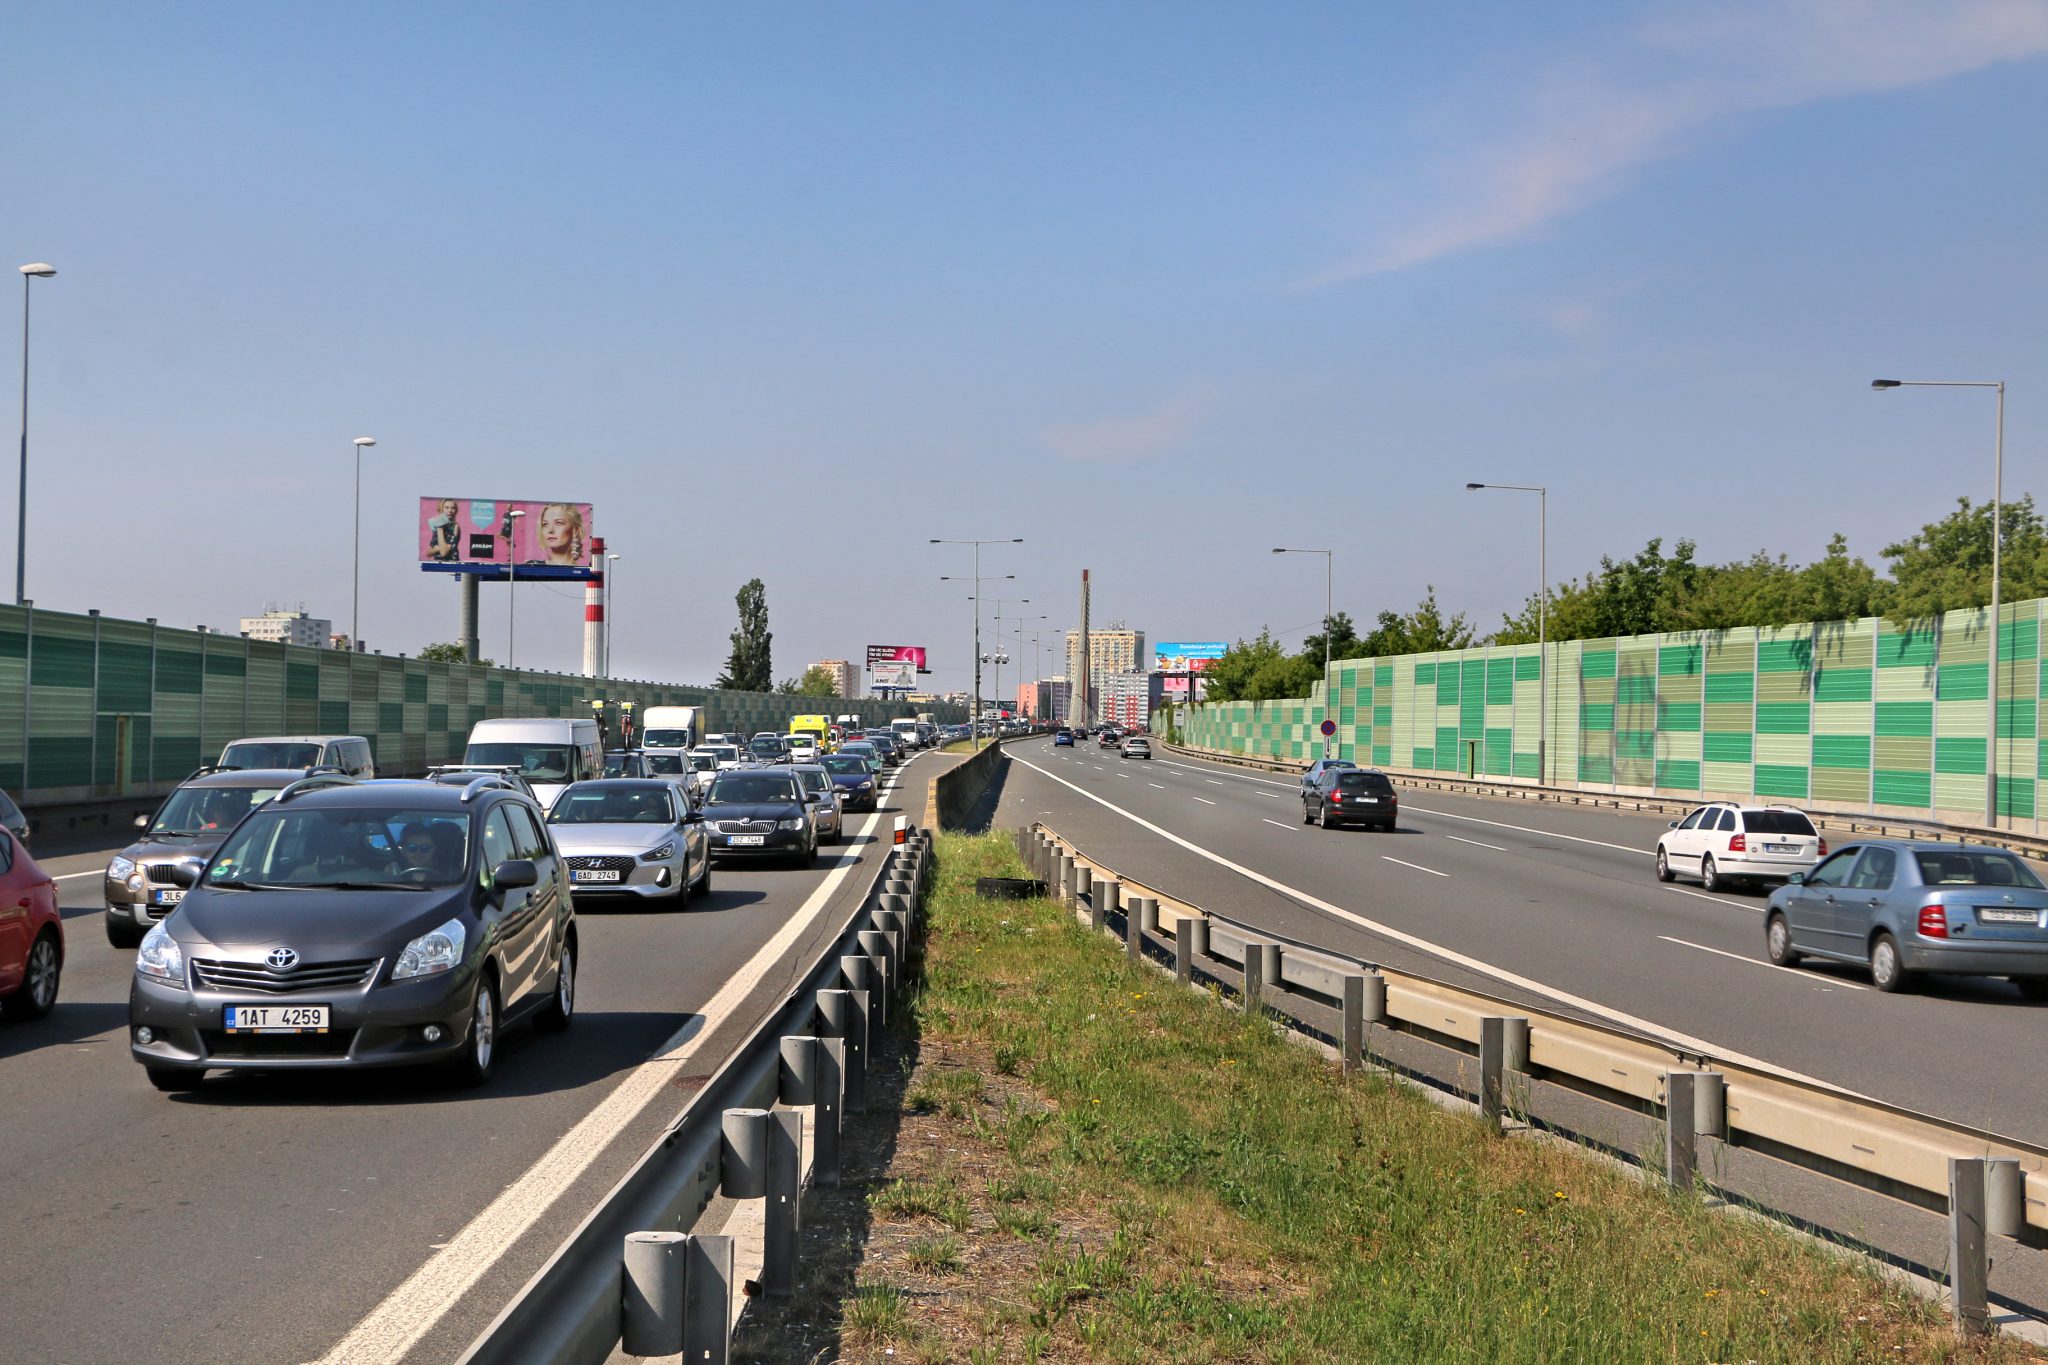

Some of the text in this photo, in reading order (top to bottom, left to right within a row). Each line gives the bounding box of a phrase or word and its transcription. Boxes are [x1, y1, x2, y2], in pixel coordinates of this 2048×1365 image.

[597, 872, 616, 880] 2749
[164, 892, 181, 901] 3L6
[240, 1009, 321, 1025] 1AT 4259
